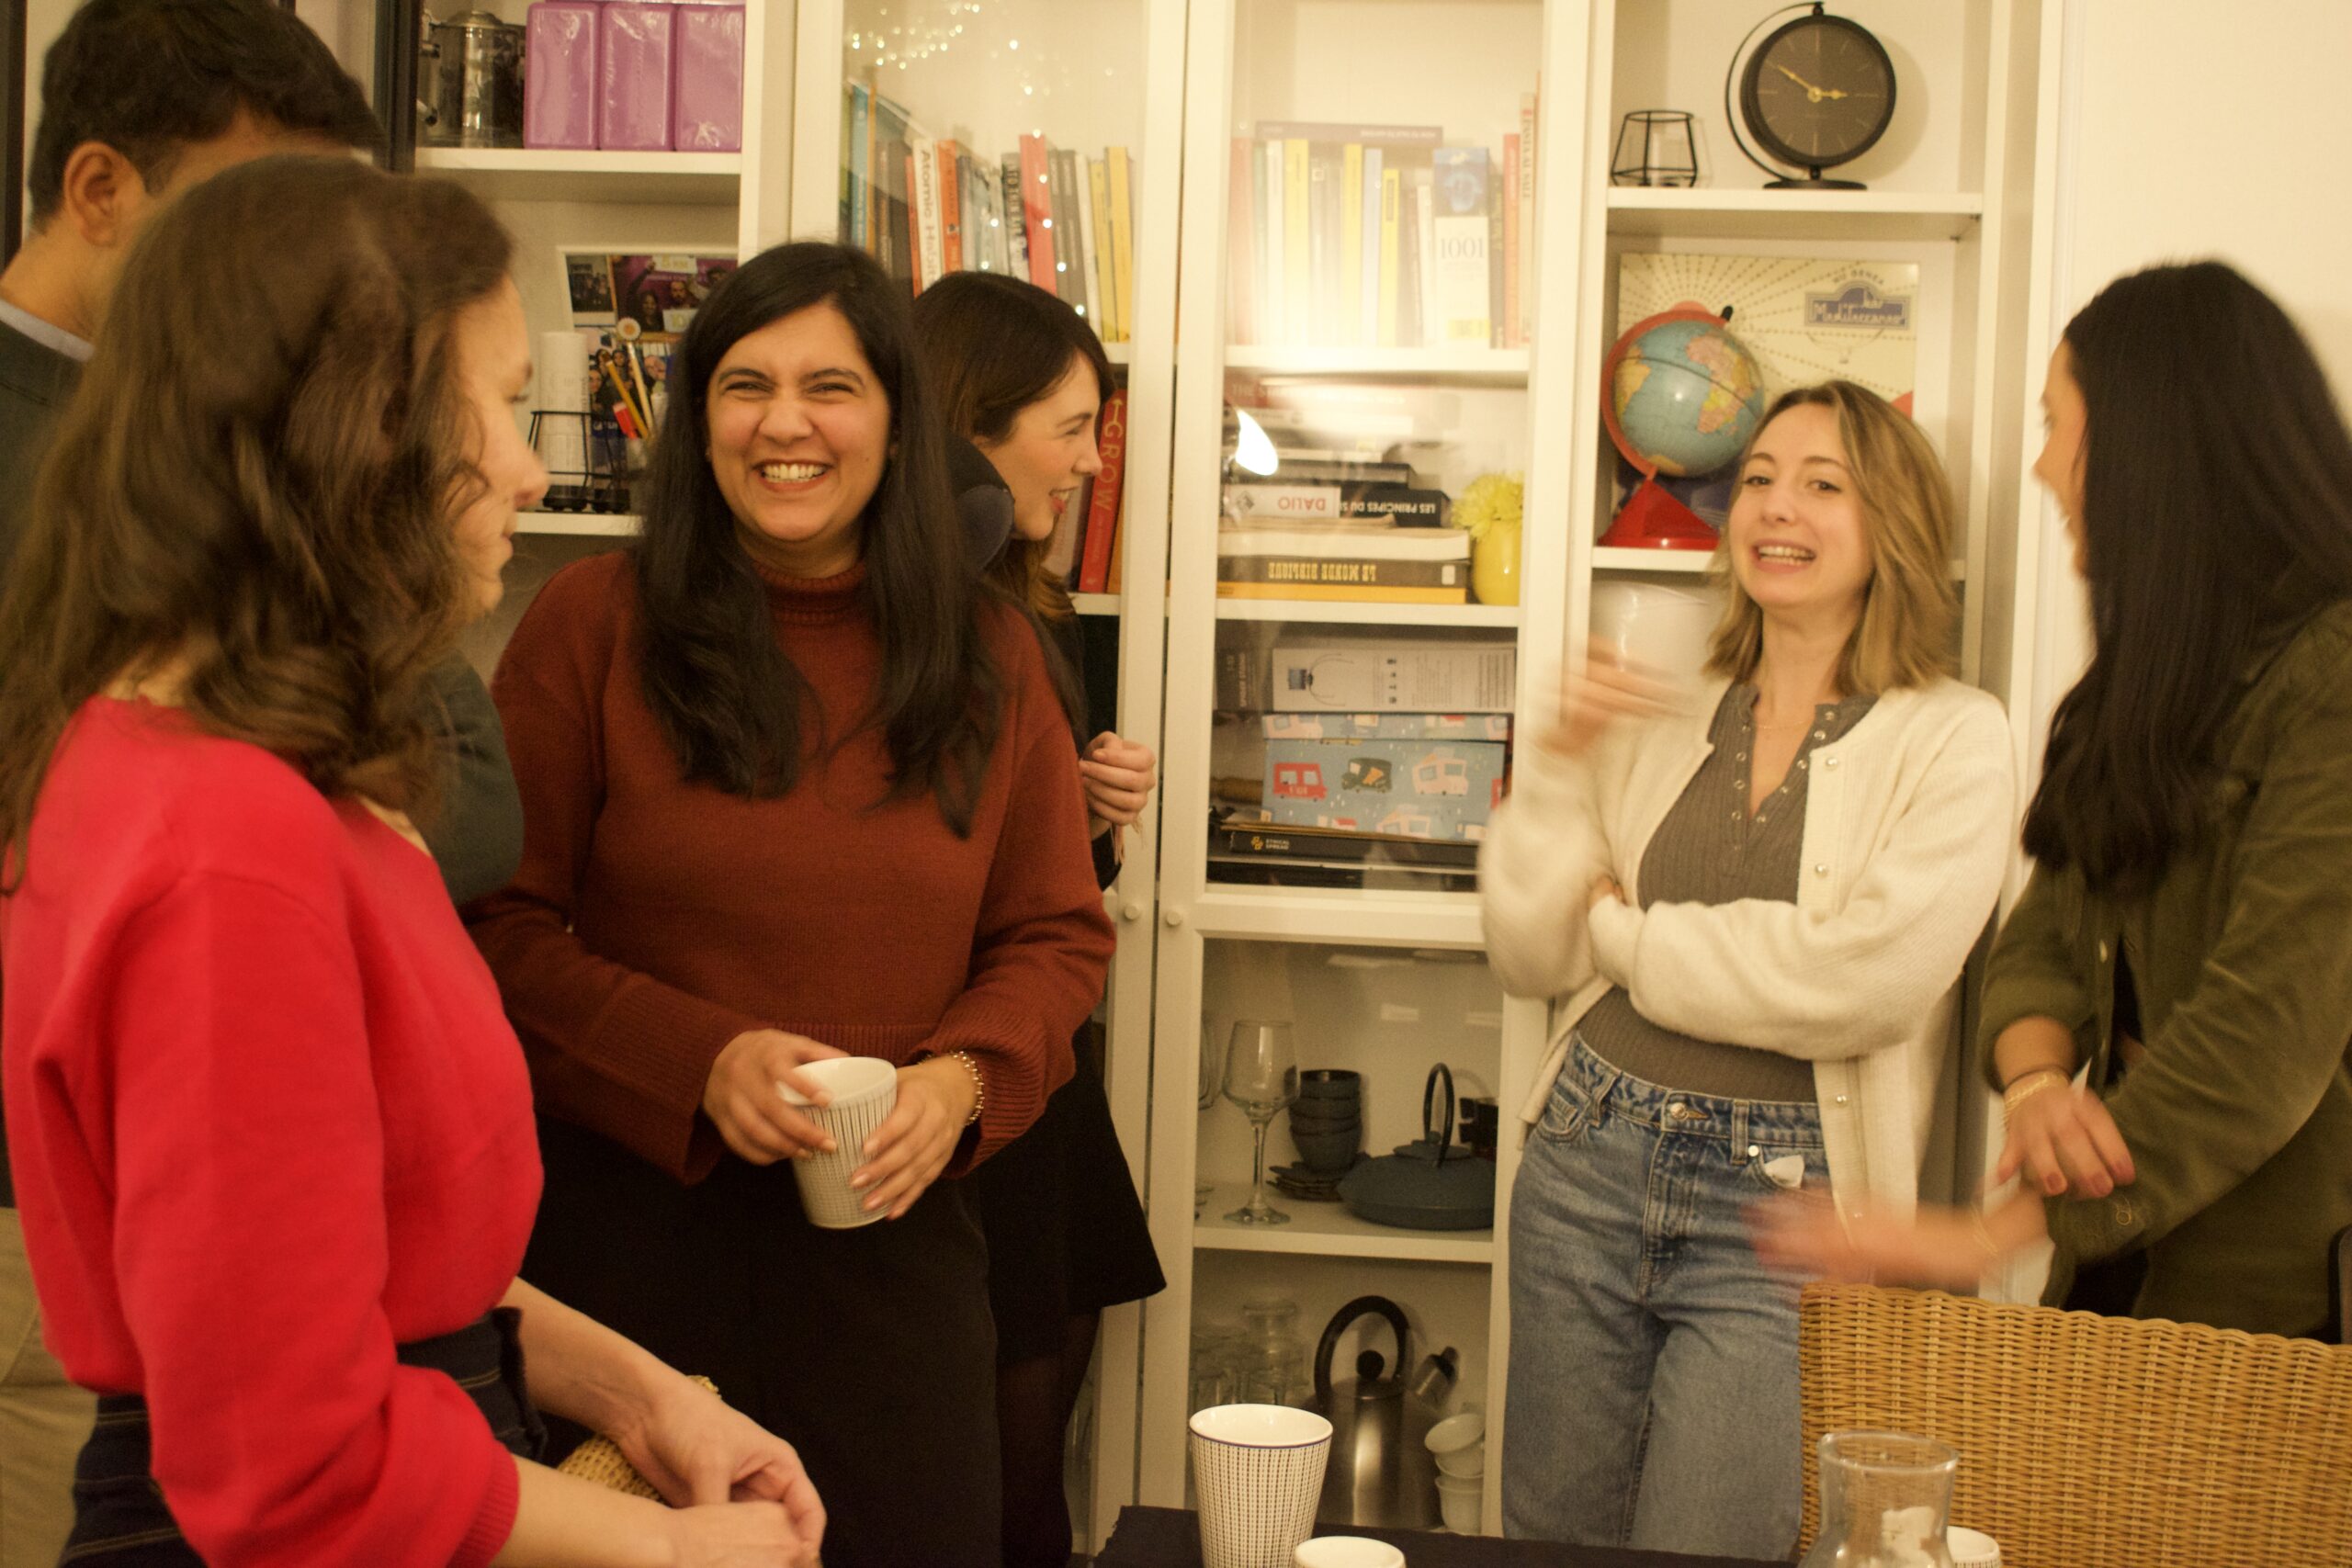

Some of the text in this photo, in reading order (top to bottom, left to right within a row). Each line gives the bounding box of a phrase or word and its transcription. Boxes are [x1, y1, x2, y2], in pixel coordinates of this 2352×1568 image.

[921, 150, 933, 219] Atomic
[1440, 237, 1485, 259] 1001
[1094, 421, 1124, 512] GROW
[1278, 497, 1326, 510] DALIO
[1350, 502, 1366, 513] DU
[1367, 502, 1418, 514] PRINCIPES
[1419, 502, 1437, 514] LES
[1268, 562, 1376, 581] LE MONDE BIBLIQUE
